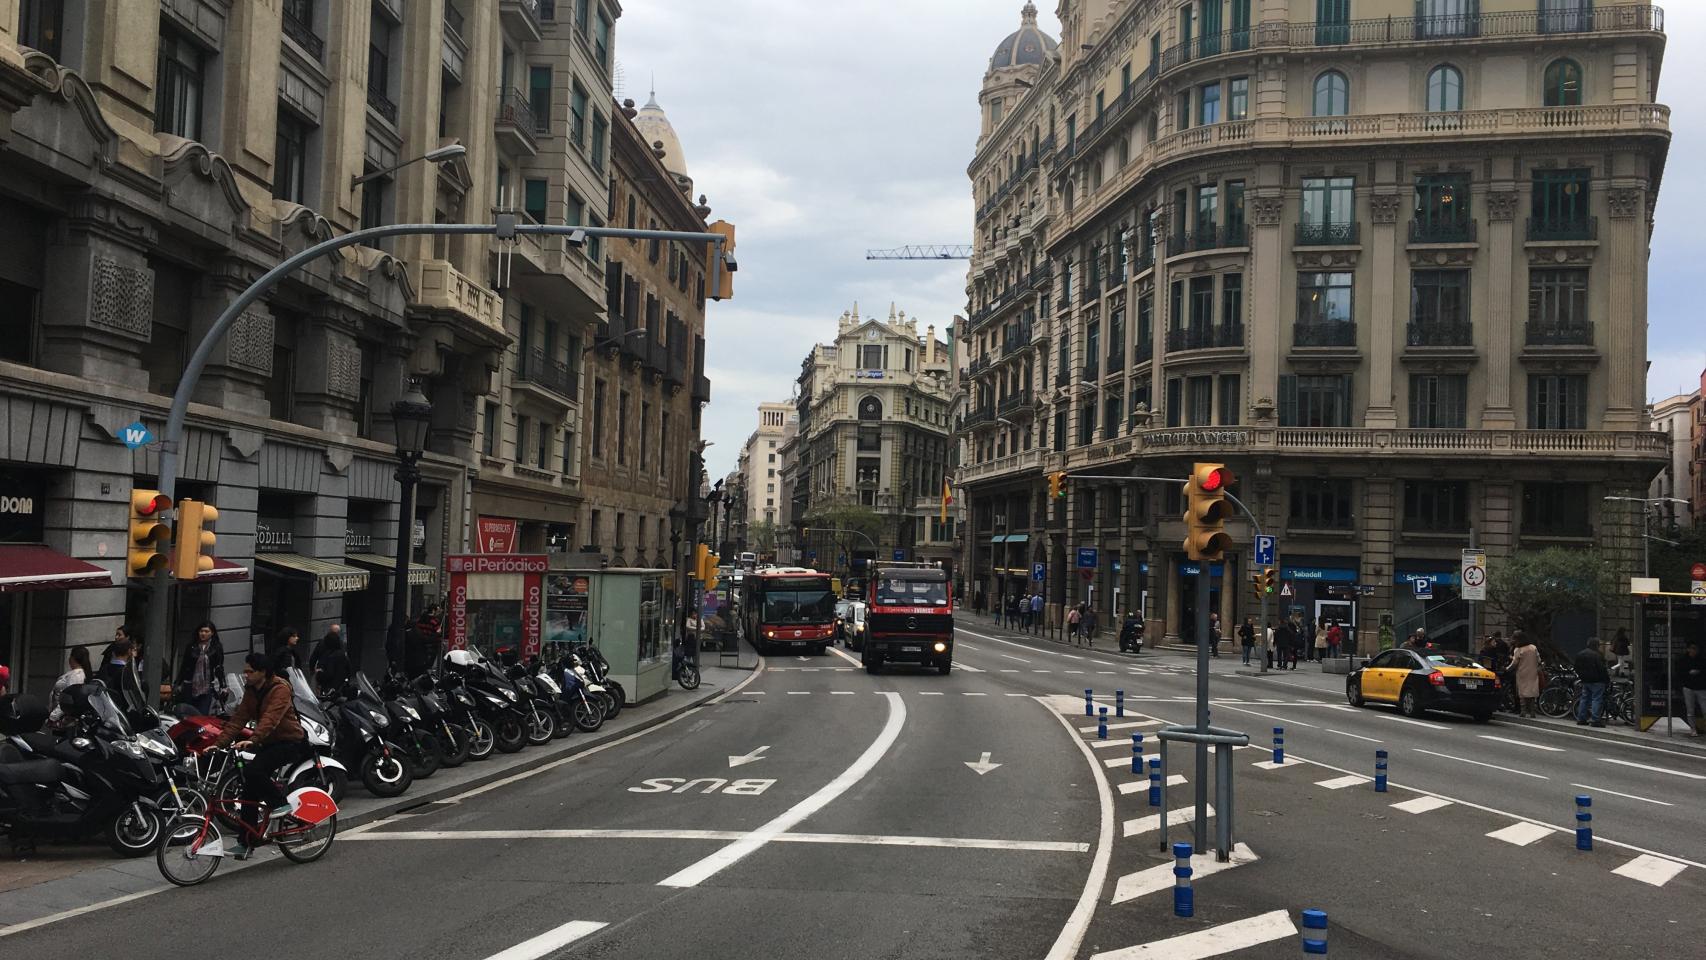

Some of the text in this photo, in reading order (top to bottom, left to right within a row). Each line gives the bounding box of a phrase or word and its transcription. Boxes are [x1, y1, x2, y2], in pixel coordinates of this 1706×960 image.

[126, 428, 146, 443] W
[345, 535, 371, 546] ODILLA
[1259, 538, 1272, 553] P
[463, 557, 546, 571] el Periódico
[1035, 564, 1043, 574] P
[1293, 571, 1322, 579] Sabadell
[329, 578, 361, 590] RODILLA
[1416, 579, 1428, 593] P
[627, 778, 778, 795] BUS
